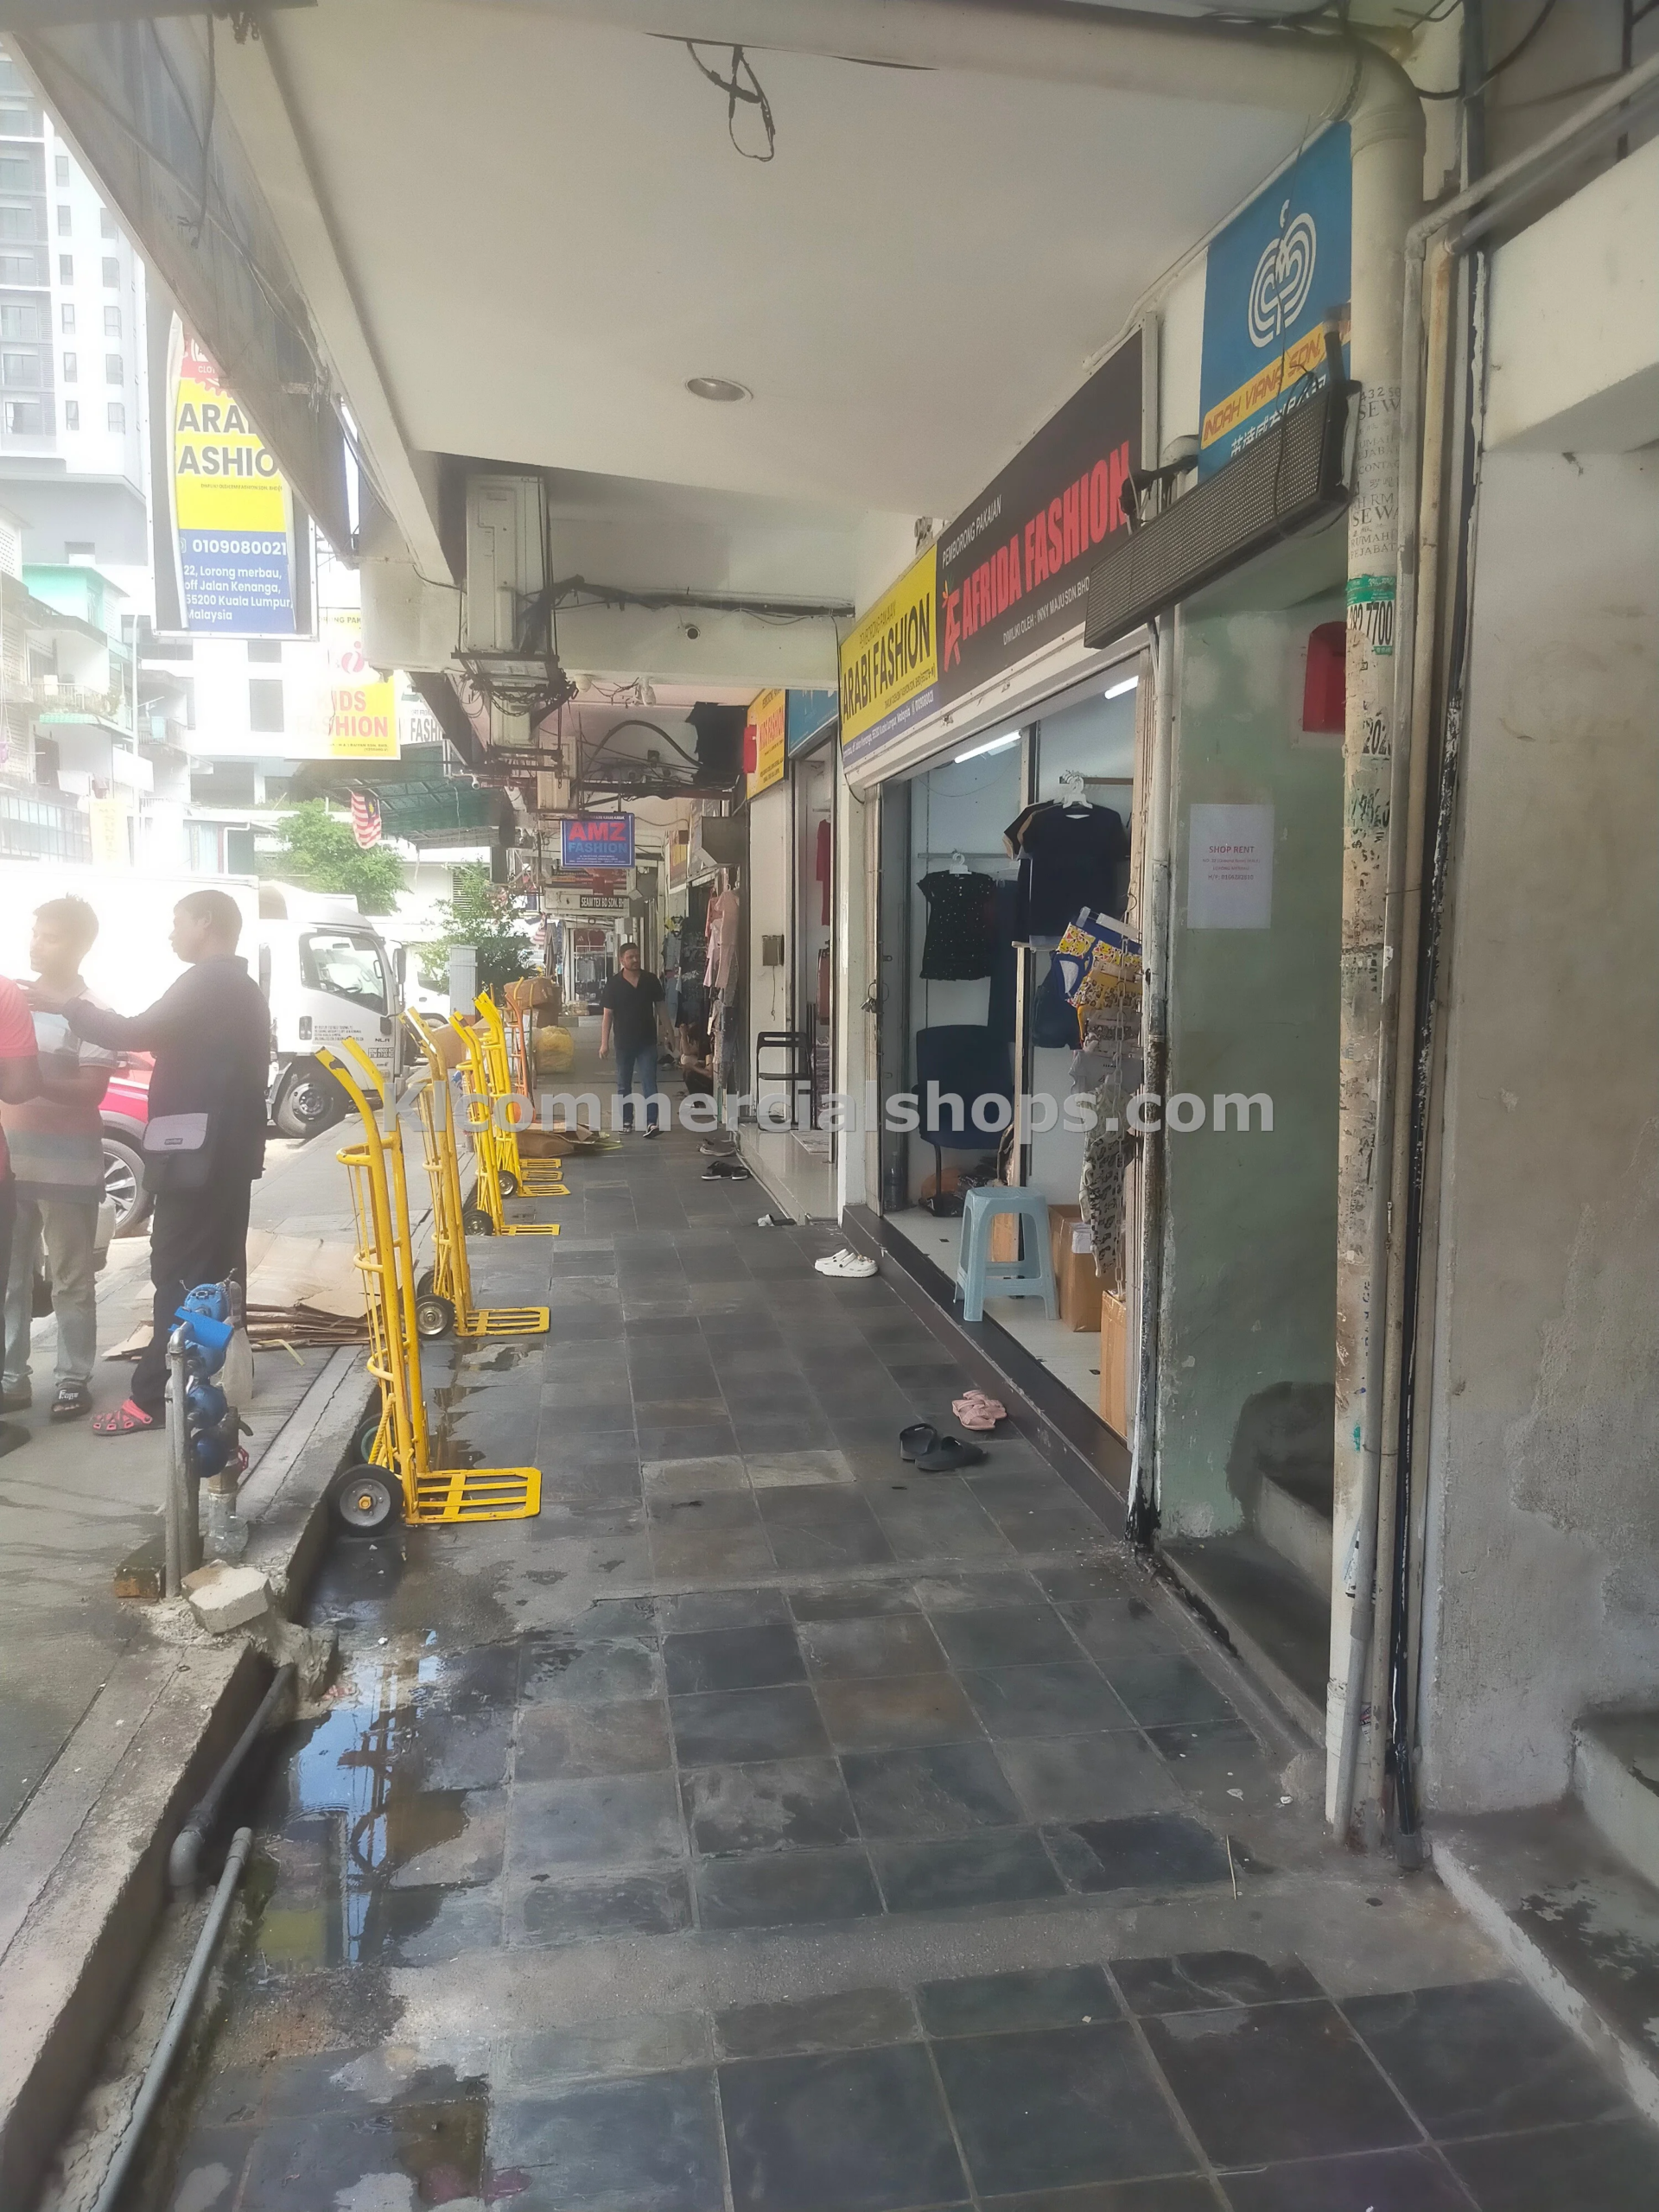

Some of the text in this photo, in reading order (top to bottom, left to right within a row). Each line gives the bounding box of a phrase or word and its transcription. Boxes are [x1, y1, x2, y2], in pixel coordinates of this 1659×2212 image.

[178, 404, 246, 434] ARA
[1203, 396, 1242, 442] INDAH
[1358, 397, 1401, 421] SEW
[178, 446, 278, 477] ASHIO
[1357, 460, 1400, 474] CONTAC
[942, 494, 1001, 569] PEMBORONG PAKAIAN
[963, 441, 1129, 641] AFRIDA FASHION
[193, 539, 287, 556] 0109080021
[184, 565, 282, 580] 22, Lorong merbau,
[185, 580, 281, 595] off Jalan Kenanga,
[218, 595, 249, 606] Kuala
[251, 596, 294, 610] Lumpur,
[1020, 613, 1034, 633] OLEH
[1050, 593, 1065, 615] MAJU
[1366, 600, 1393, 645] 7700
[843, 592, 931, 724] ARABI FASHION
[569, 822, 626, 842] AMZ
[568, 842, 628, 854] FASHION
[1209, 845, 1255, 854] SHOP RENT
